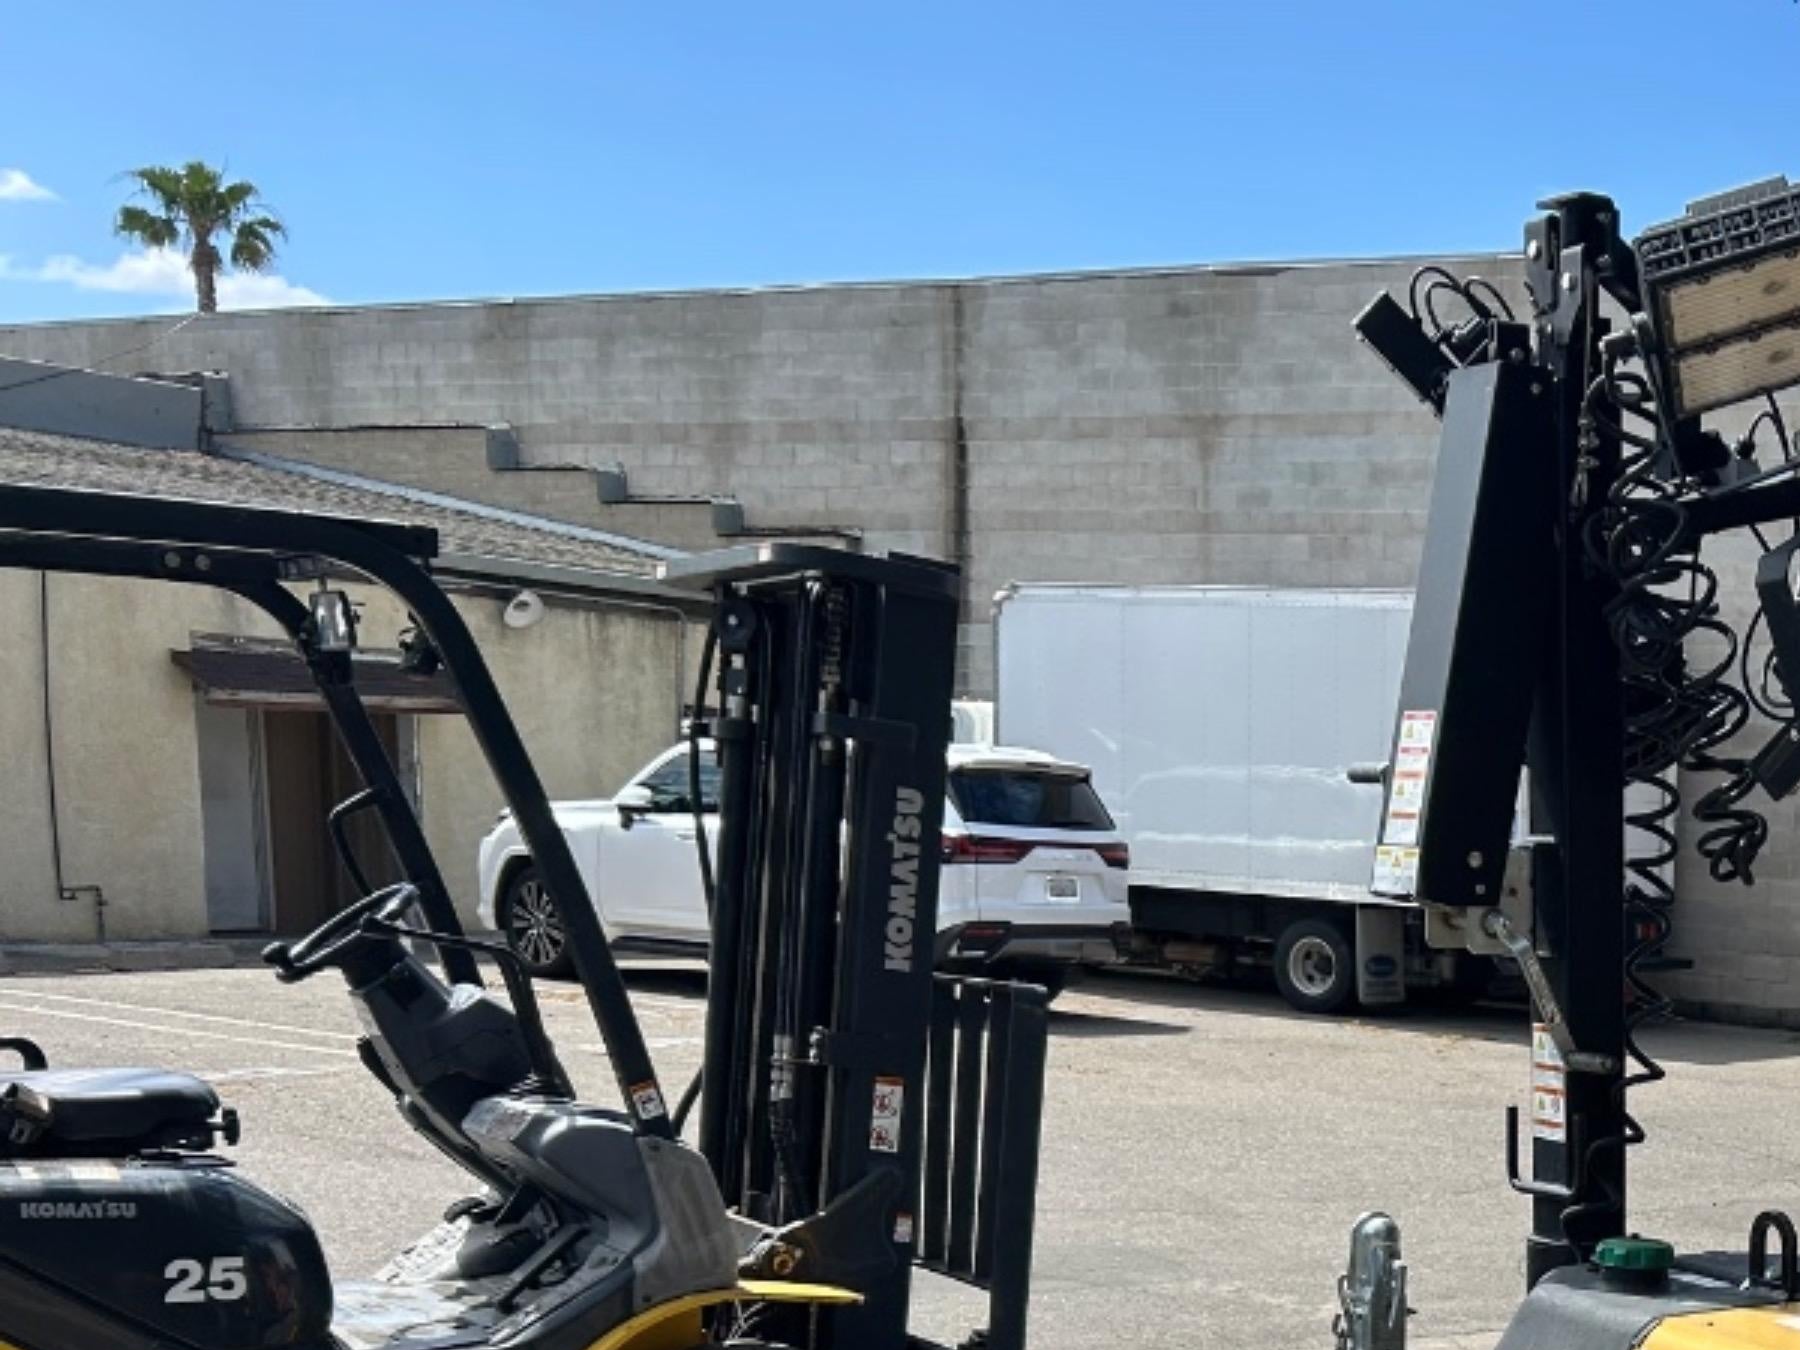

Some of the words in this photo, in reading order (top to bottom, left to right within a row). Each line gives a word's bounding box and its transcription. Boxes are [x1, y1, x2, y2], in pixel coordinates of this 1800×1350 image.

[884, 786, 924, 972] KOMATSU
[20, 1200, 137, 1219] KOMATSU
[164, 1256, 248, 1304] 25
